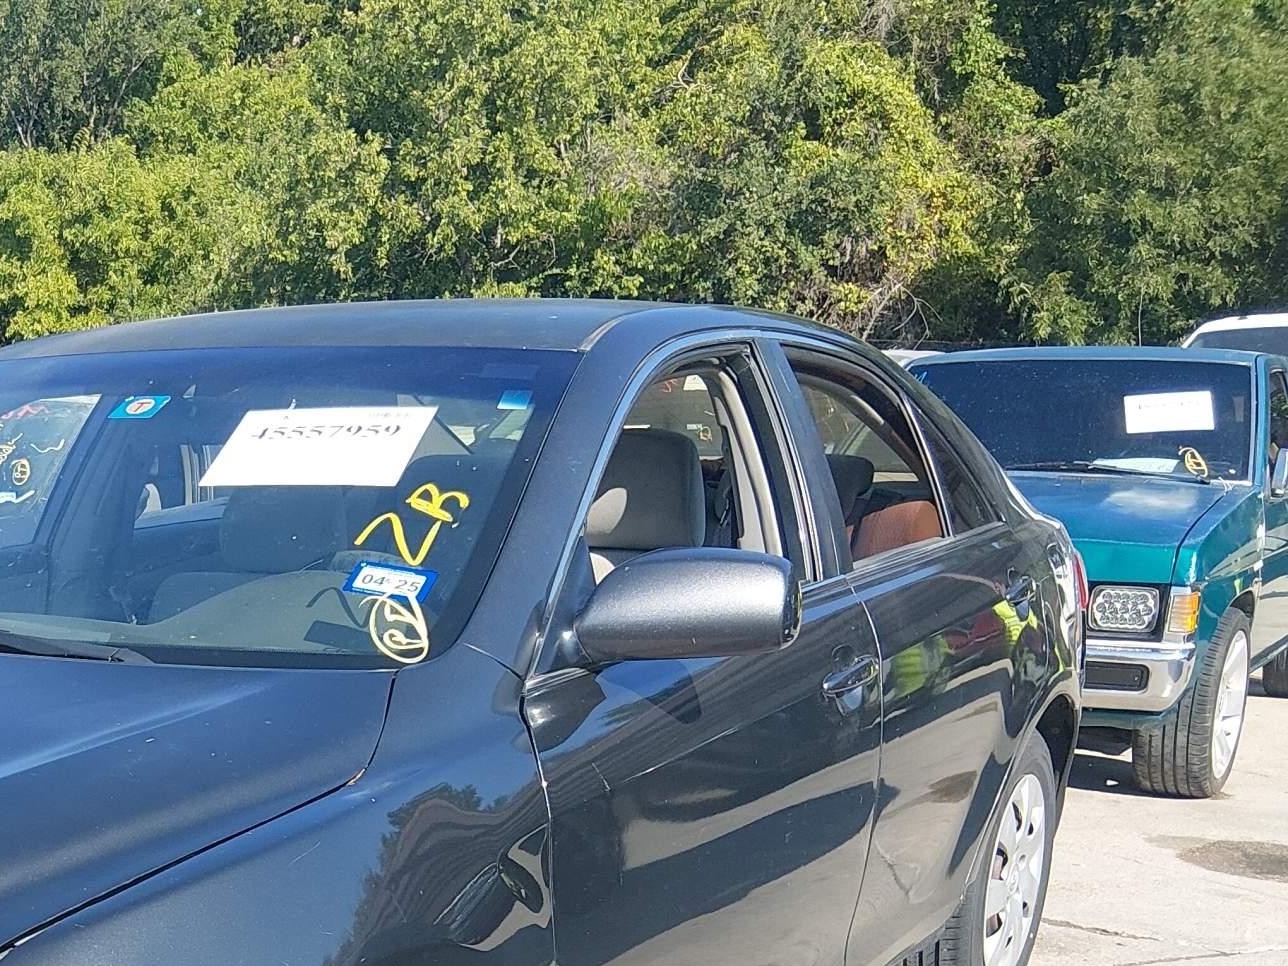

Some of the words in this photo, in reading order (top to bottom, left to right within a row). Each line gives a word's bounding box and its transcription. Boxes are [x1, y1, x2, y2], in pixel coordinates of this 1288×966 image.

[251, 424, 402, 440] 45557959
[361, 573, 385, 586] 04
[394, 578, 421, 593] 25
